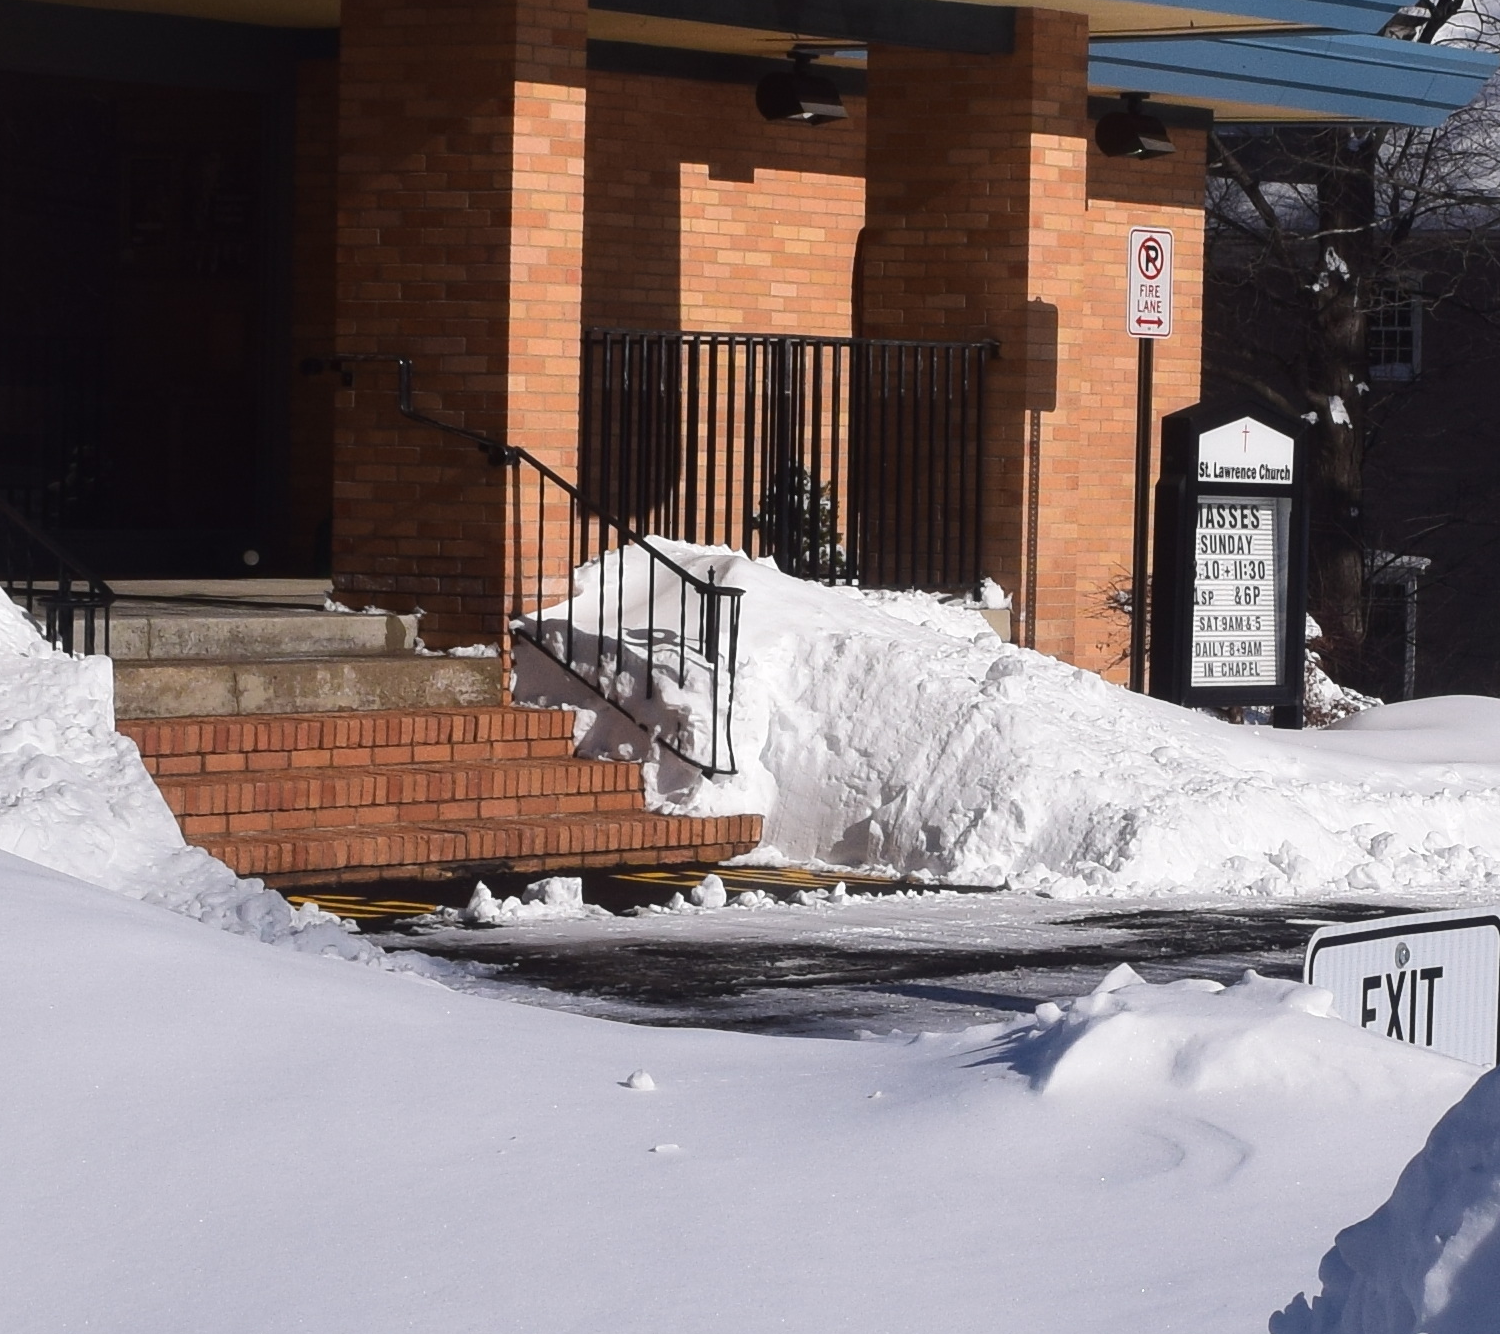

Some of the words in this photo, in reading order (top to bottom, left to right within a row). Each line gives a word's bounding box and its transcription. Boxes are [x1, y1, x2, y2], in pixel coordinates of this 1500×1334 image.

[1139, 283, 1161, 299] FIRE
[1137, 299, 1163, 315] LANE
[1198, 461, 1211, 478] St.
[1213, 462, 1257, 481] Lawrence
[1259, 464, 1291, 482] Church
[1200, 535, 1253, 554] SUNDAY
[1199, 616, 1218, 631] SAT
[1195, 642, 1224, 657] DAILY
[1204, 663, 1214, 677] IN
[1221, 662, 1260, 676] CHAPEL
[1361, 966, 1443, 1047] EXIT
